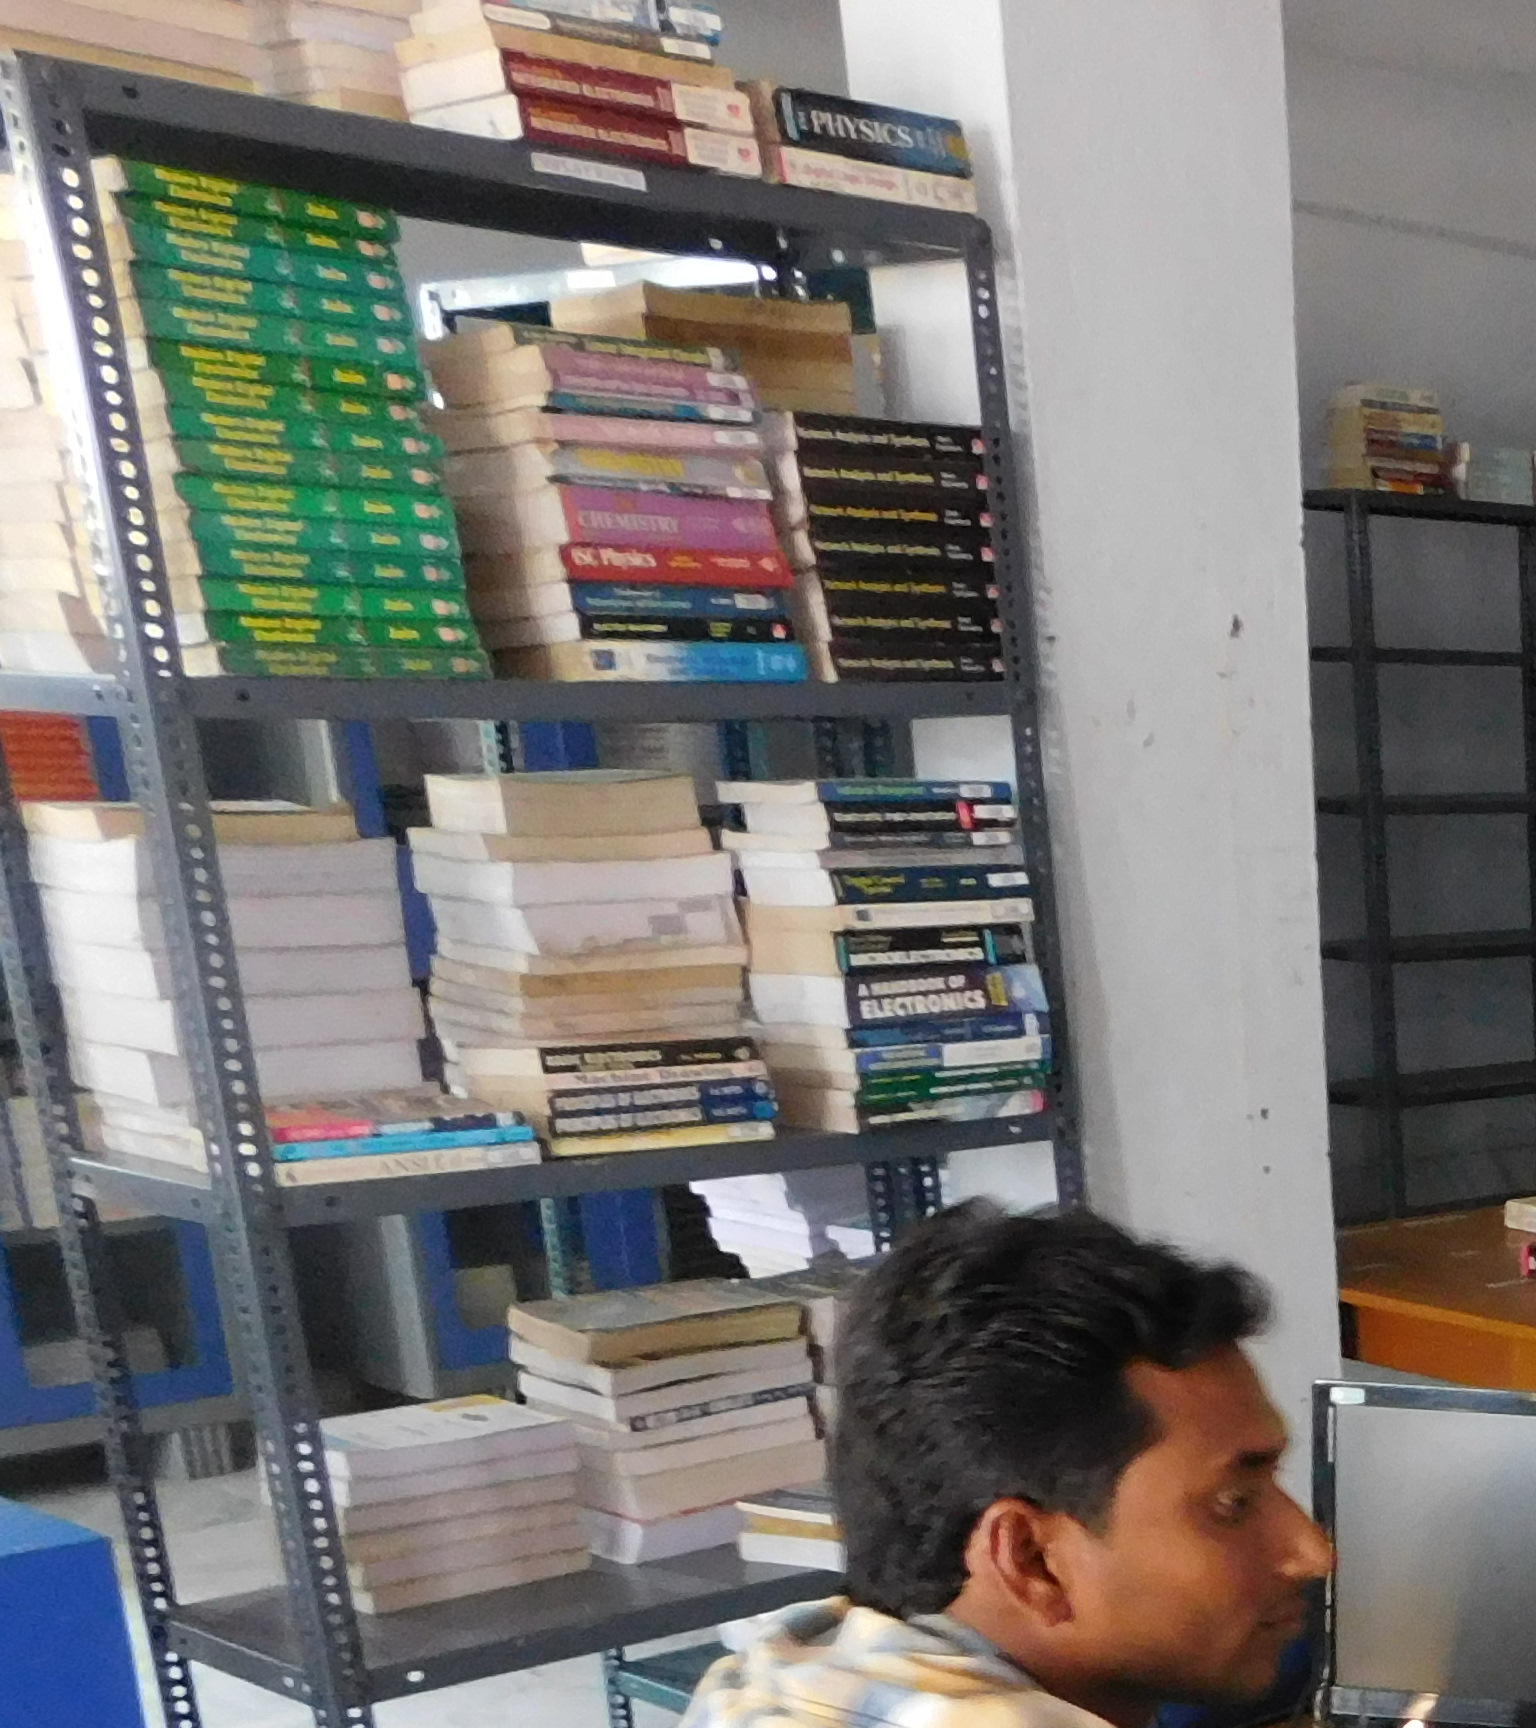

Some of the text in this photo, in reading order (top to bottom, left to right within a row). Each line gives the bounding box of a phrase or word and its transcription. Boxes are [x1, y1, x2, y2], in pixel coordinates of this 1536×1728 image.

[810, 109, 914, 148] PHYSICS
[578, 510, 680, 533] CHEMISTRY
[858, 983, 869, 997] A
[860, 989, 986, 1019] ELECTRONICS
